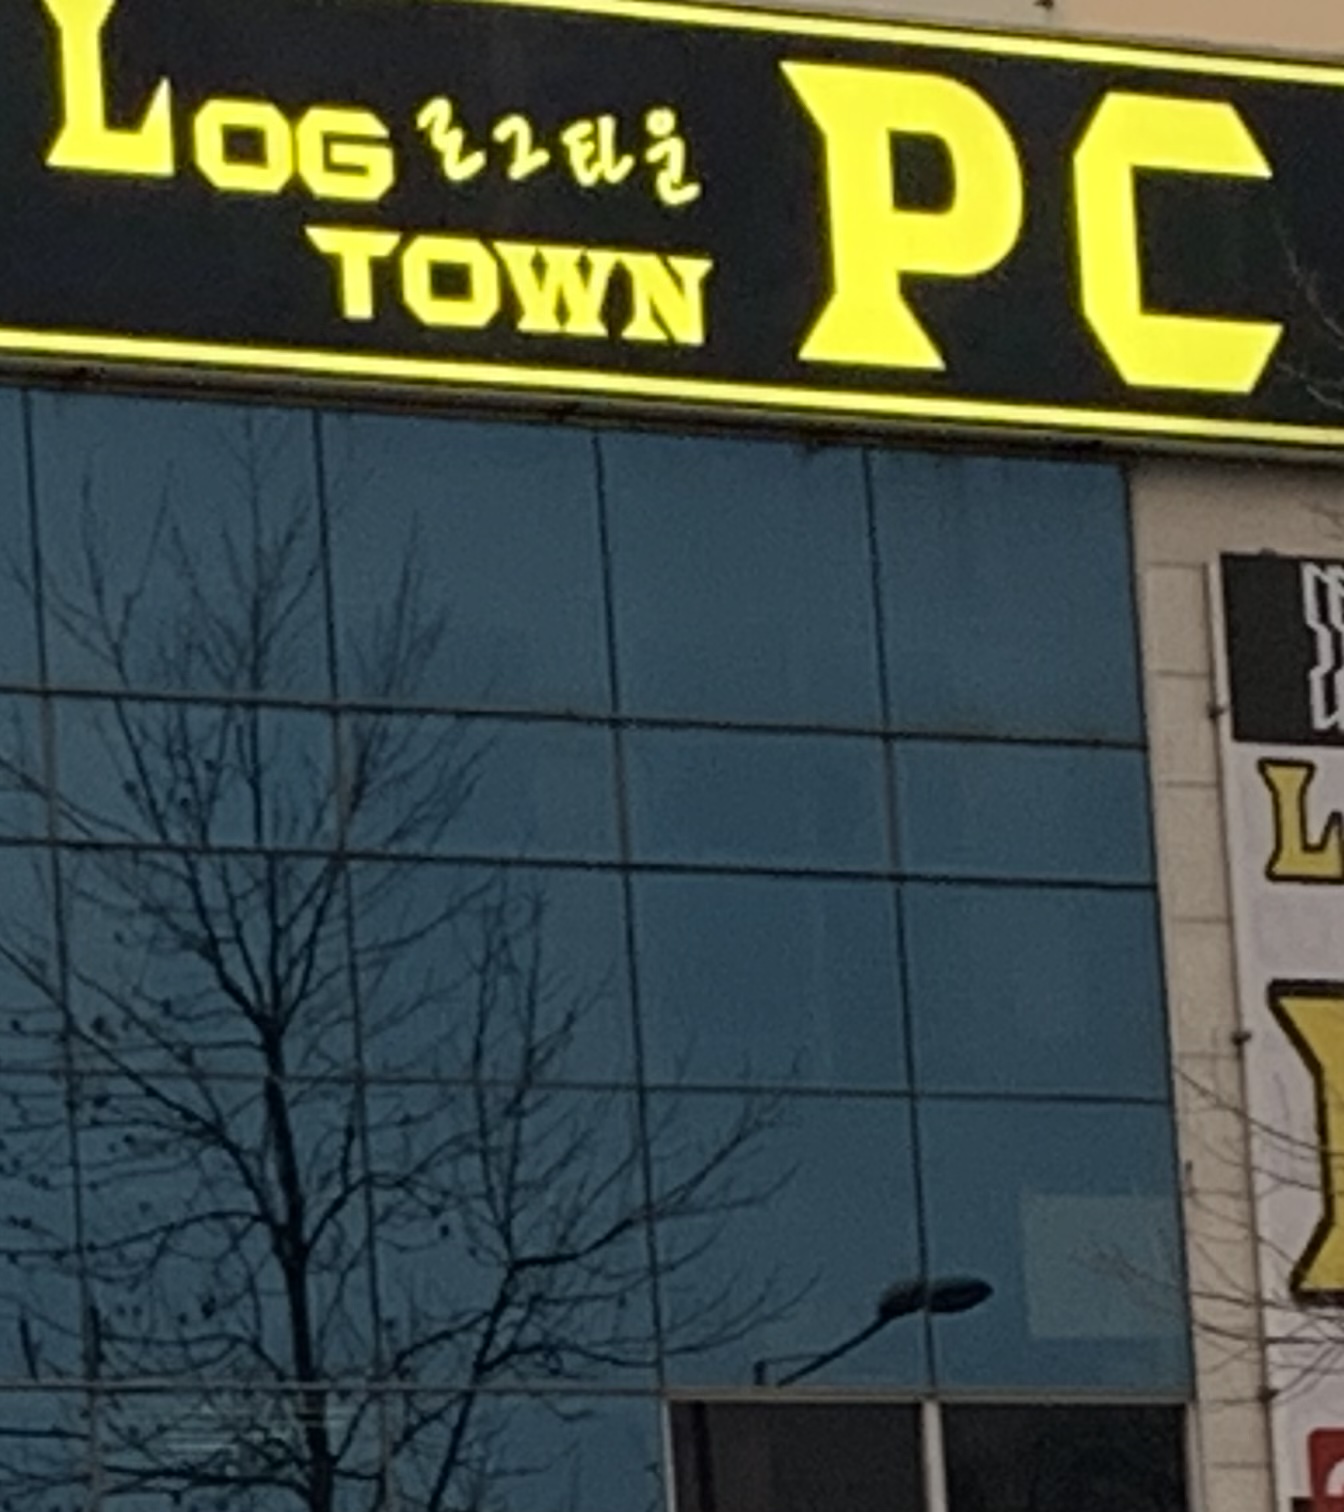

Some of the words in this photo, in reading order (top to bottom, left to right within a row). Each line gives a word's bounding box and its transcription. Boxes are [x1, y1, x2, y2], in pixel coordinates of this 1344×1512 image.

[43, 0, 394, 201] LOG
[304, 224, 714, 347] TOWN
[779, 60, 1284, 394] PC
